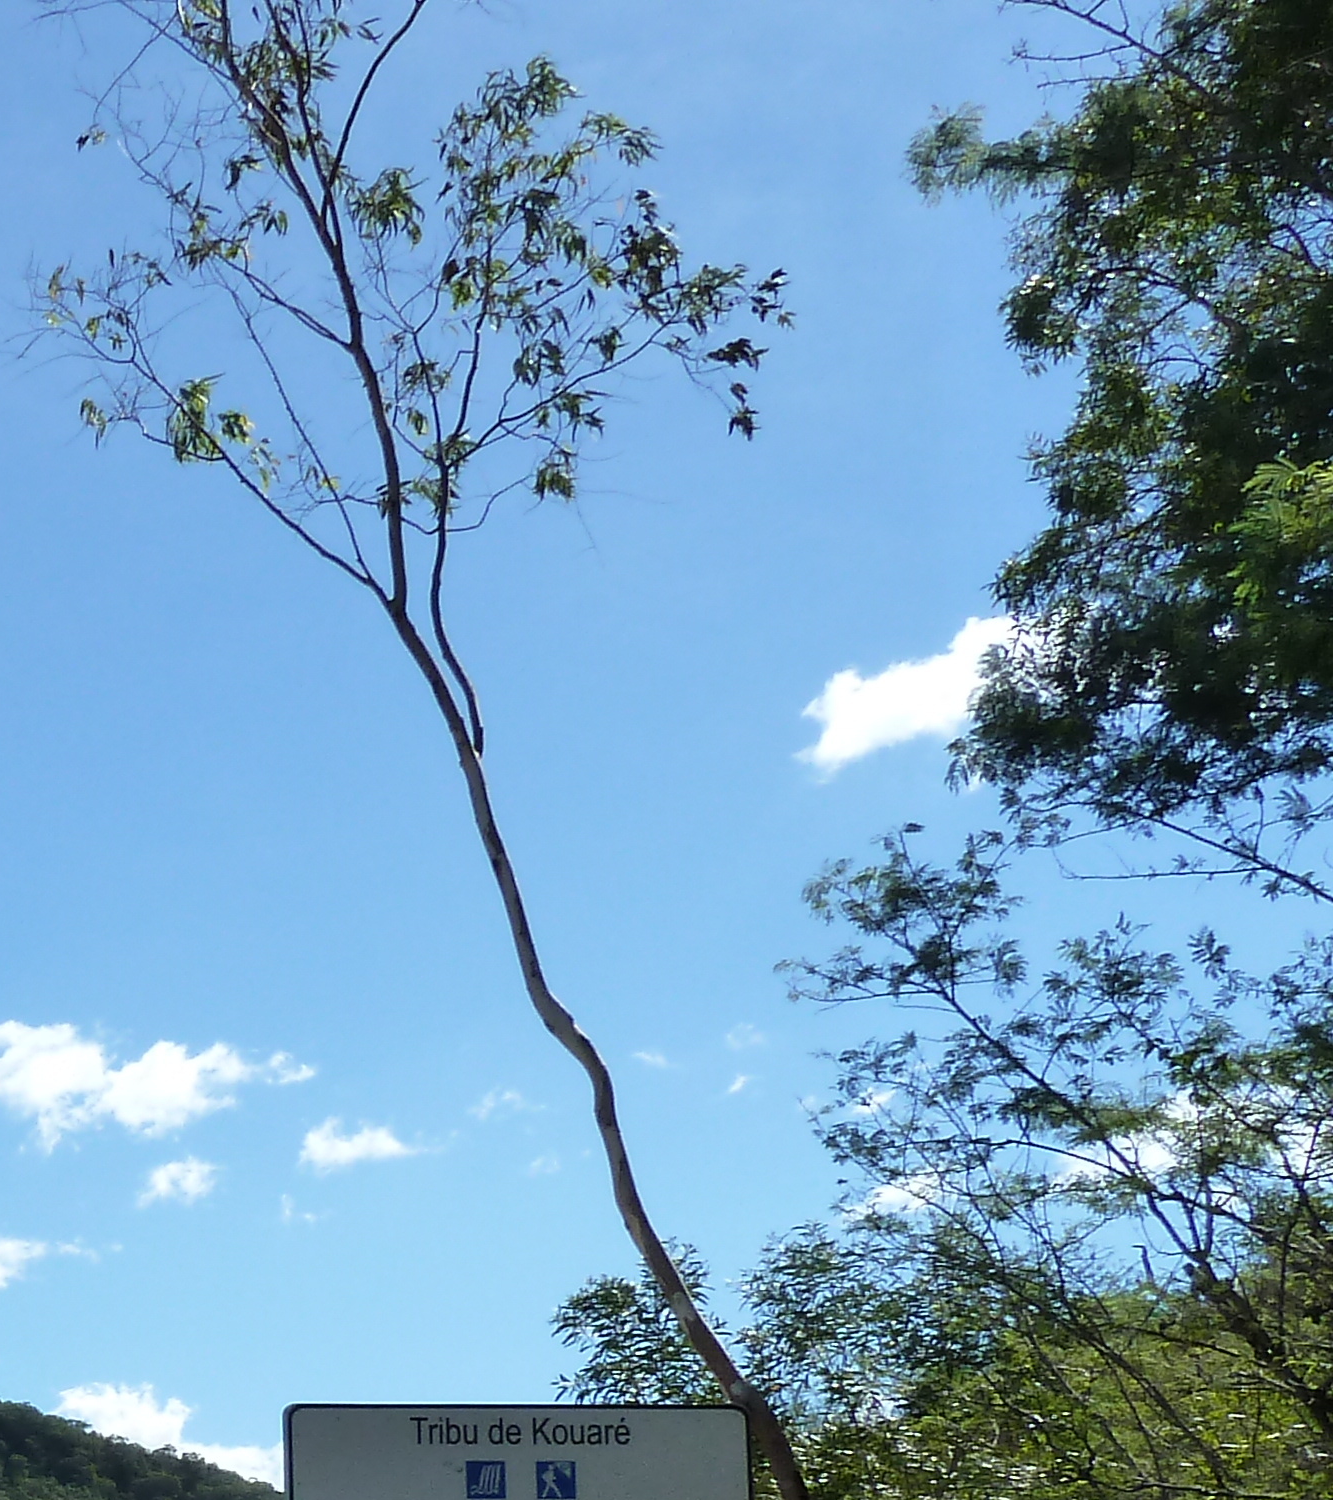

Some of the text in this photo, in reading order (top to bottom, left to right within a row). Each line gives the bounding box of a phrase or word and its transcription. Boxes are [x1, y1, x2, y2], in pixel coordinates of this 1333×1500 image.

[409, 1416, 631, 1446] Tribu de Kouaré
